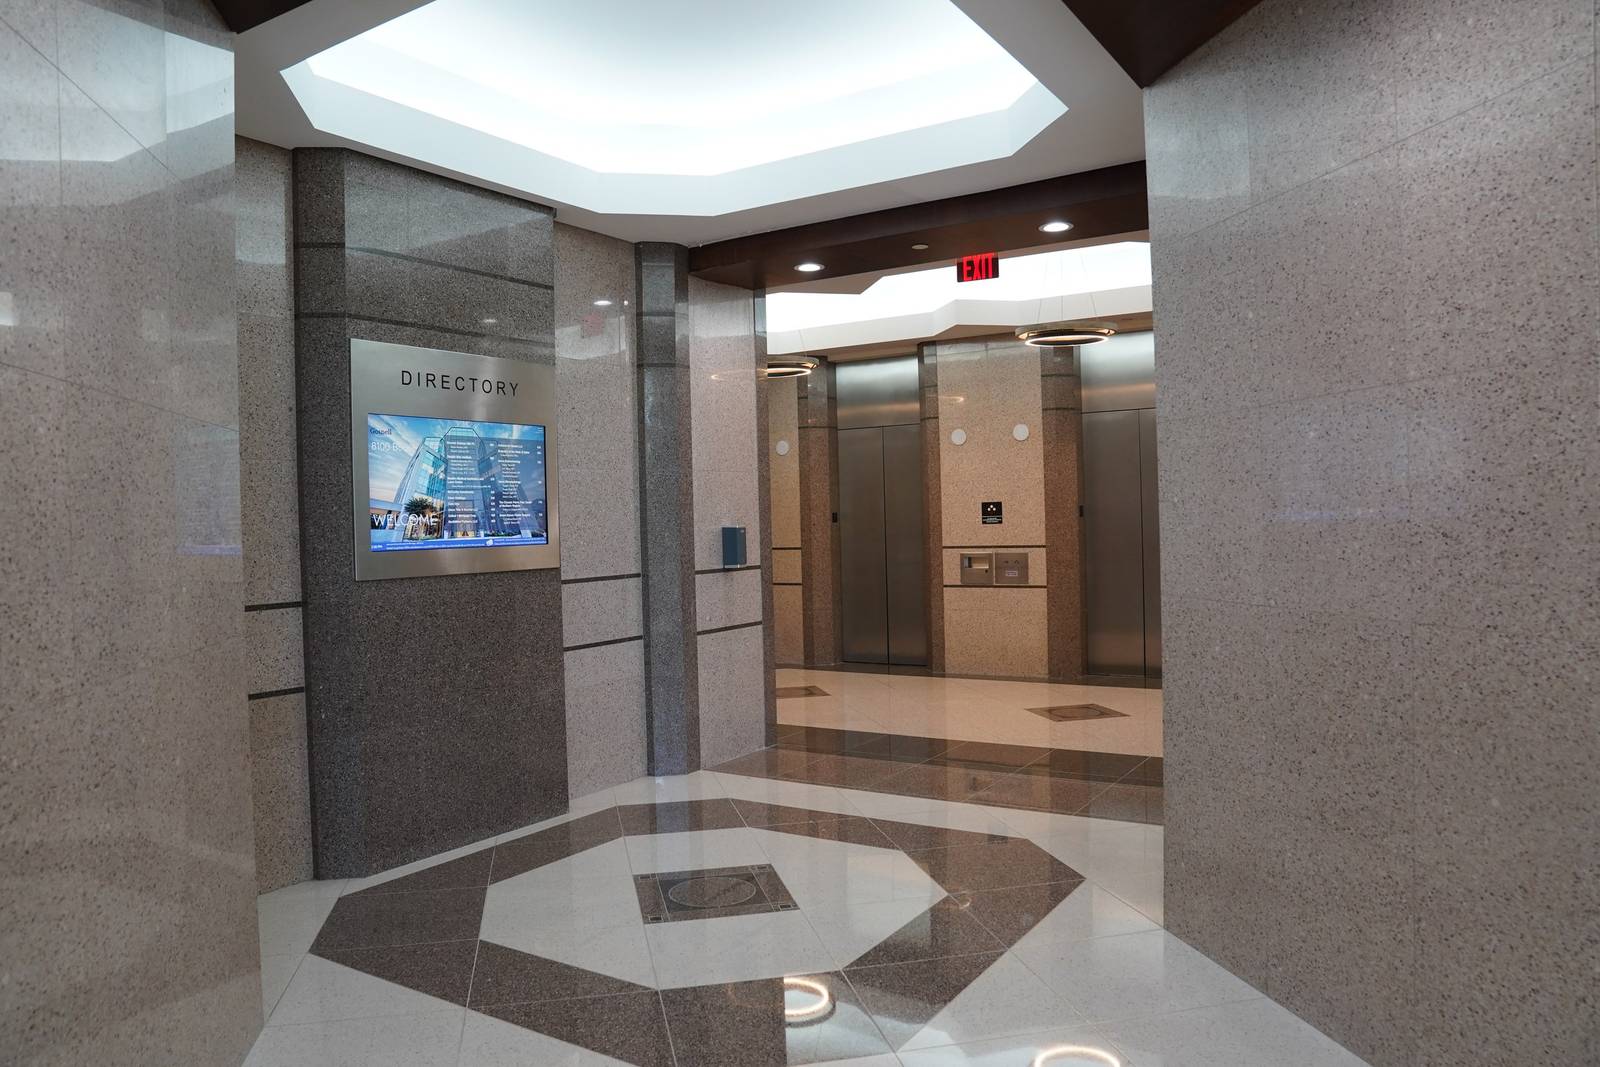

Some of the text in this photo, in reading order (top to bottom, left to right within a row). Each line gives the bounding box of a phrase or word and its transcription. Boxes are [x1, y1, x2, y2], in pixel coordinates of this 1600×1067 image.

[962, 253, 995, 282] EXIT
[401, 370, 519, 397] DIRECTORY
[372, 513, 439, 527] WELCOME
